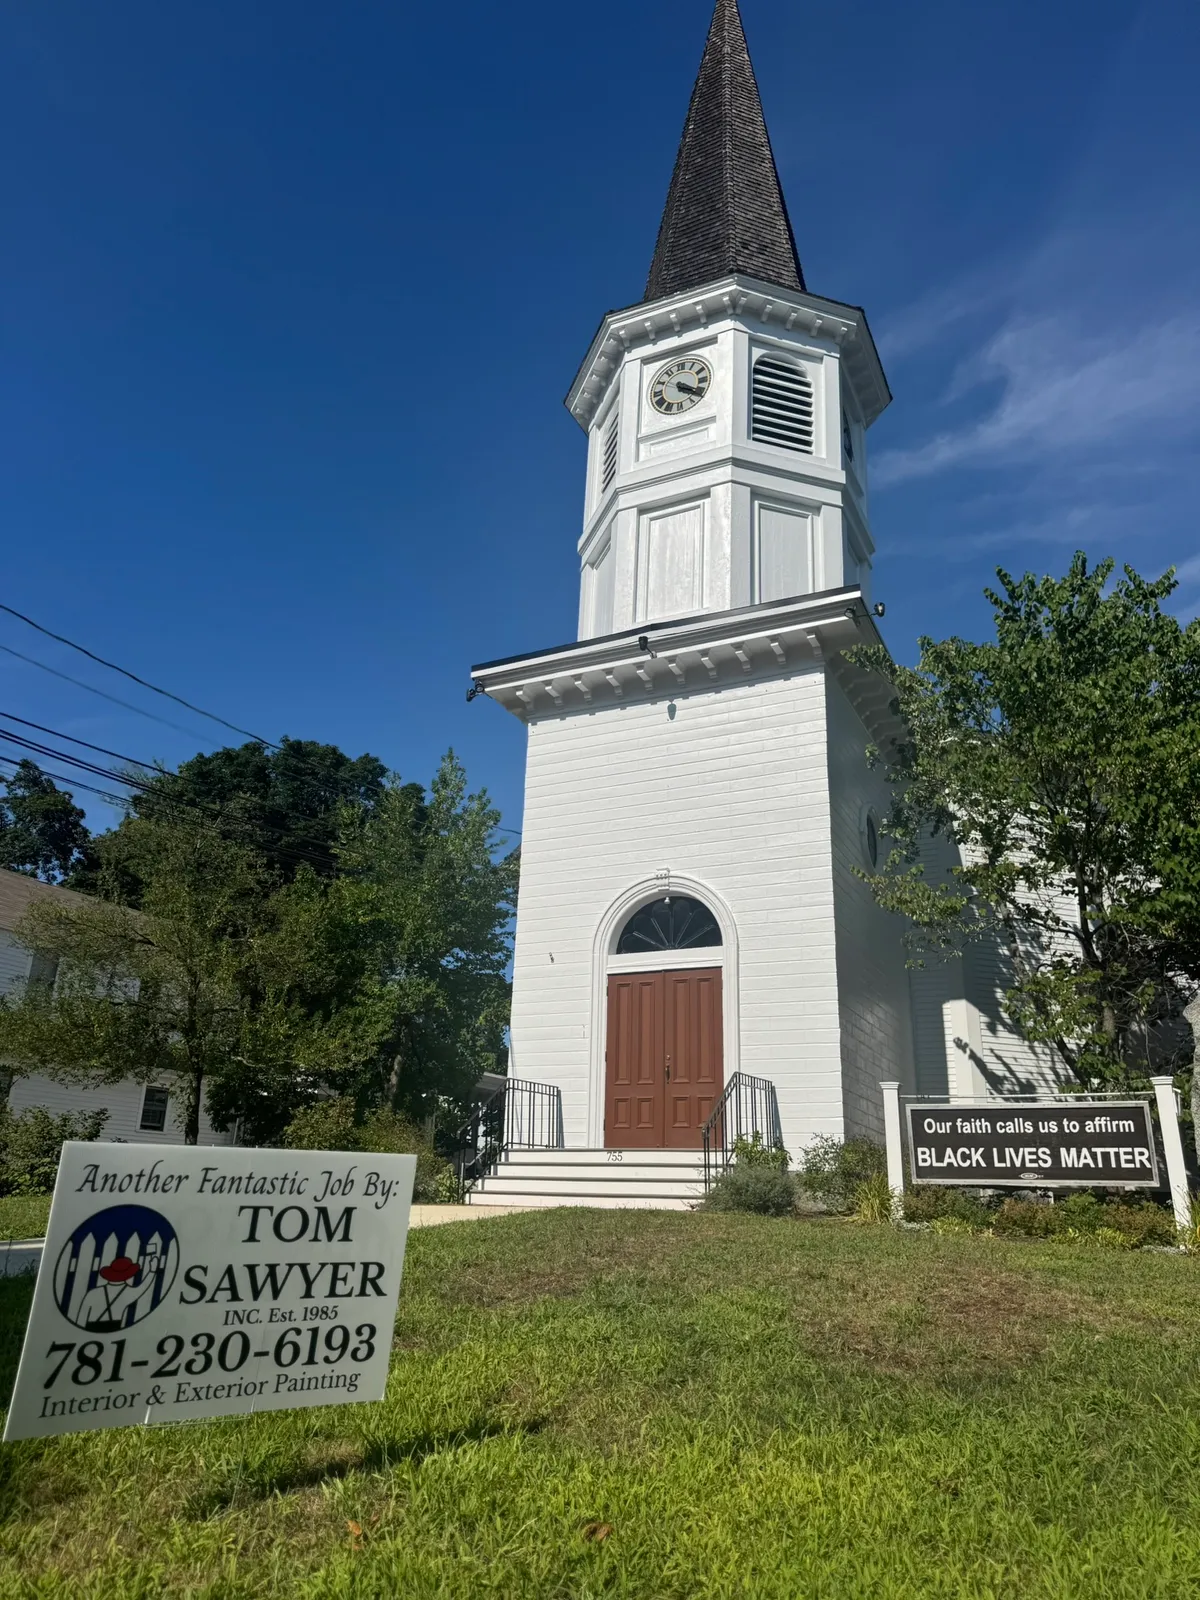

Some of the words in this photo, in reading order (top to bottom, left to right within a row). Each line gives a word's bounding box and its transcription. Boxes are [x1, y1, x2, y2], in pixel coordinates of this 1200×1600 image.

[923, 1118, 952, 1134] Our
[956, 1118, 991, 1134] faith
[996, 1118, 1034, 1133] calls
[1038, 1121, 1058, 1133] us
[1062, 1118, 1079, 1133] to
[1085, 1117, 1135, 1133] affirm
[607, 1150, 623, 1161] 755
[917, 1147, 987, 1168] BLACK
[993, 1147, 1052, 1168] LIVES
[1060, 1147, 1151, 1169] MATTER
[75, 1159, 190, 1194] Another
[197, 1167, 310, 1196] Fantastic
[313, 1166, 358, 1203] Job
[362, 1171, 400, 1210] By:
[238, 1205, 357, 1243] TOM
[179, 1261, 387, 1305] SAWYER
[222, 1309, 263, 1326] INC.
[268, 1307, 298, 1324] Est.
[302, 1305, 339, 1321] 1985
[43, 1323, 377, 1390] 781-230-6193
[38, 1387, 141, 1419] Interior
[145, 1384, 167, 1405] &
[173, 1376, 268, 1404] Exterior
[274, 1369, 361, 1394] Painting
